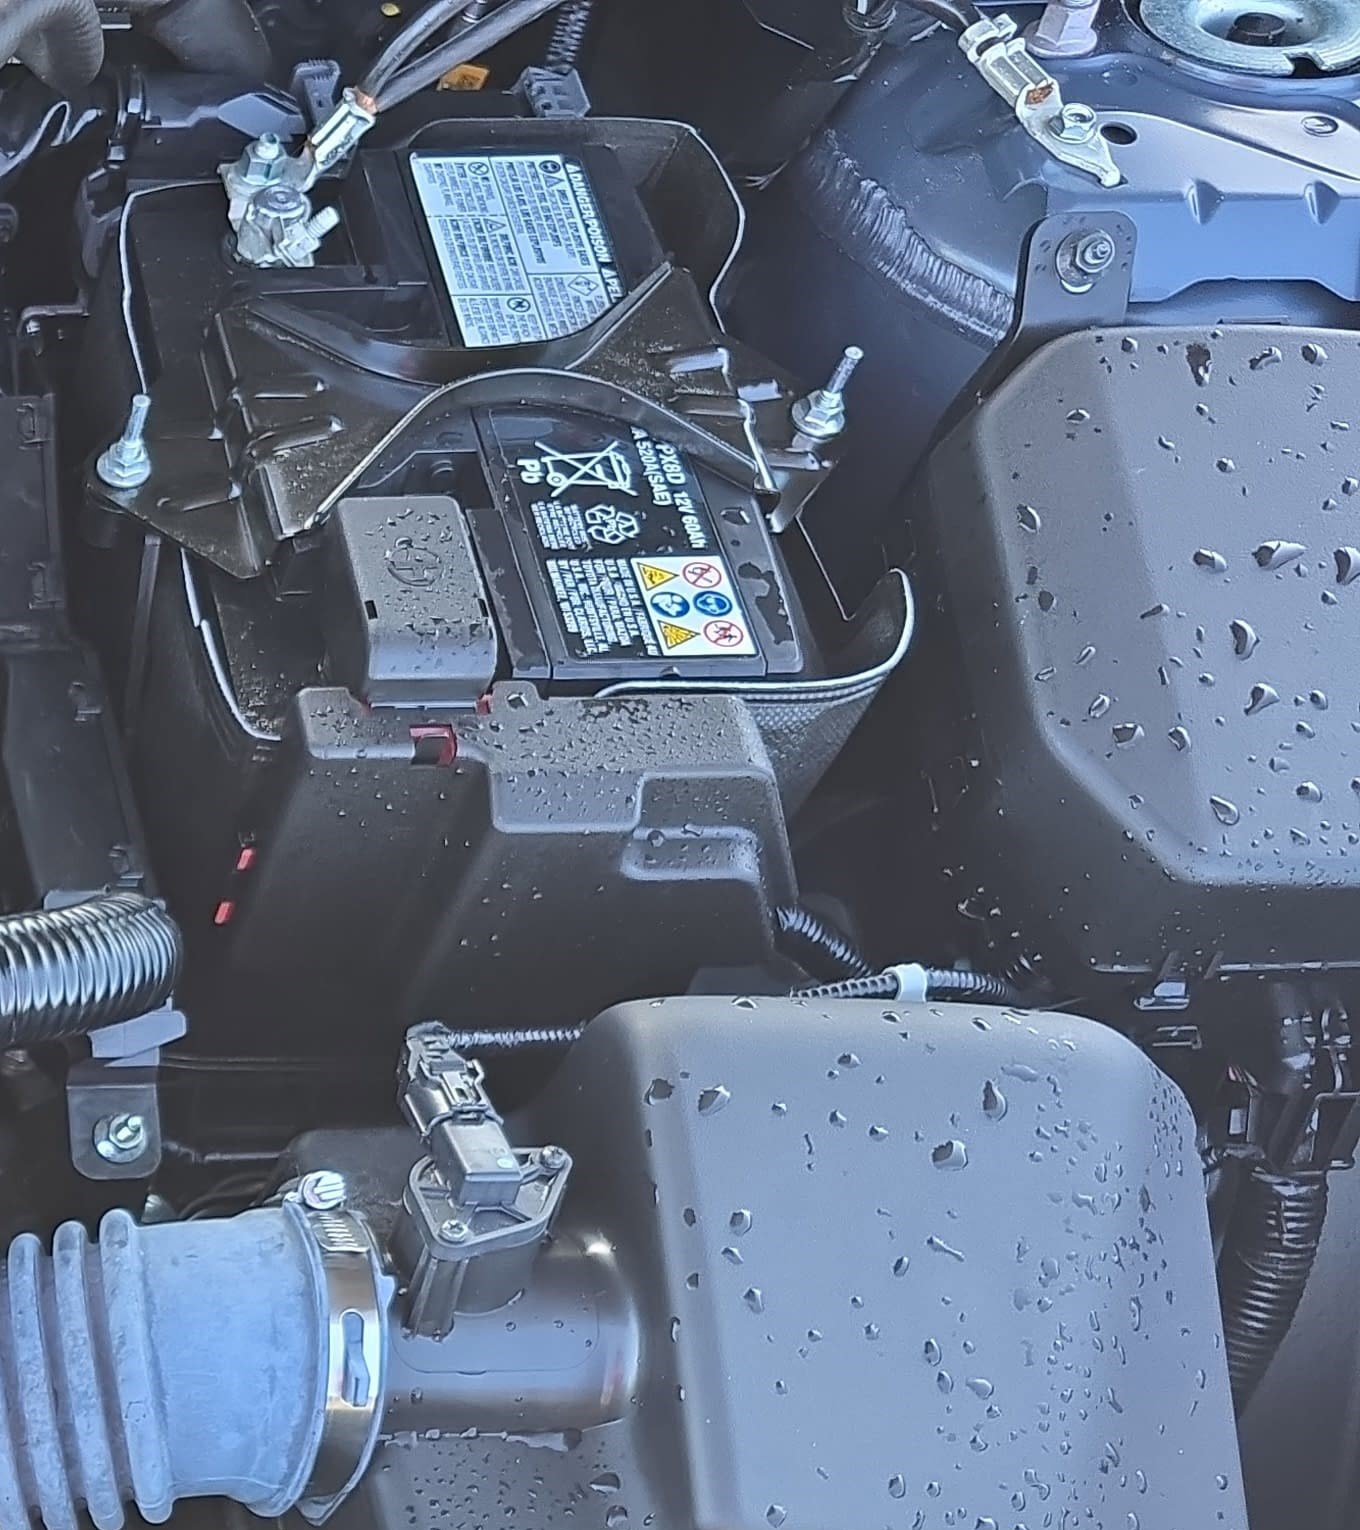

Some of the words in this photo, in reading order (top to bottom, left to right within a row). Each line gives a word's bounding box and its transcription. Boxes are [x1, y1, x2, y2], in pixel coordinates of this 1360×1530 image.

[516, 457, 543, 486] Pb
[634, 441, 673, 507] 520A(SAE)
[655, 445, 686, 484] PX8D
[672, 491, 696, 514] 12V
[682, 515, 708, 549] 60Ah
